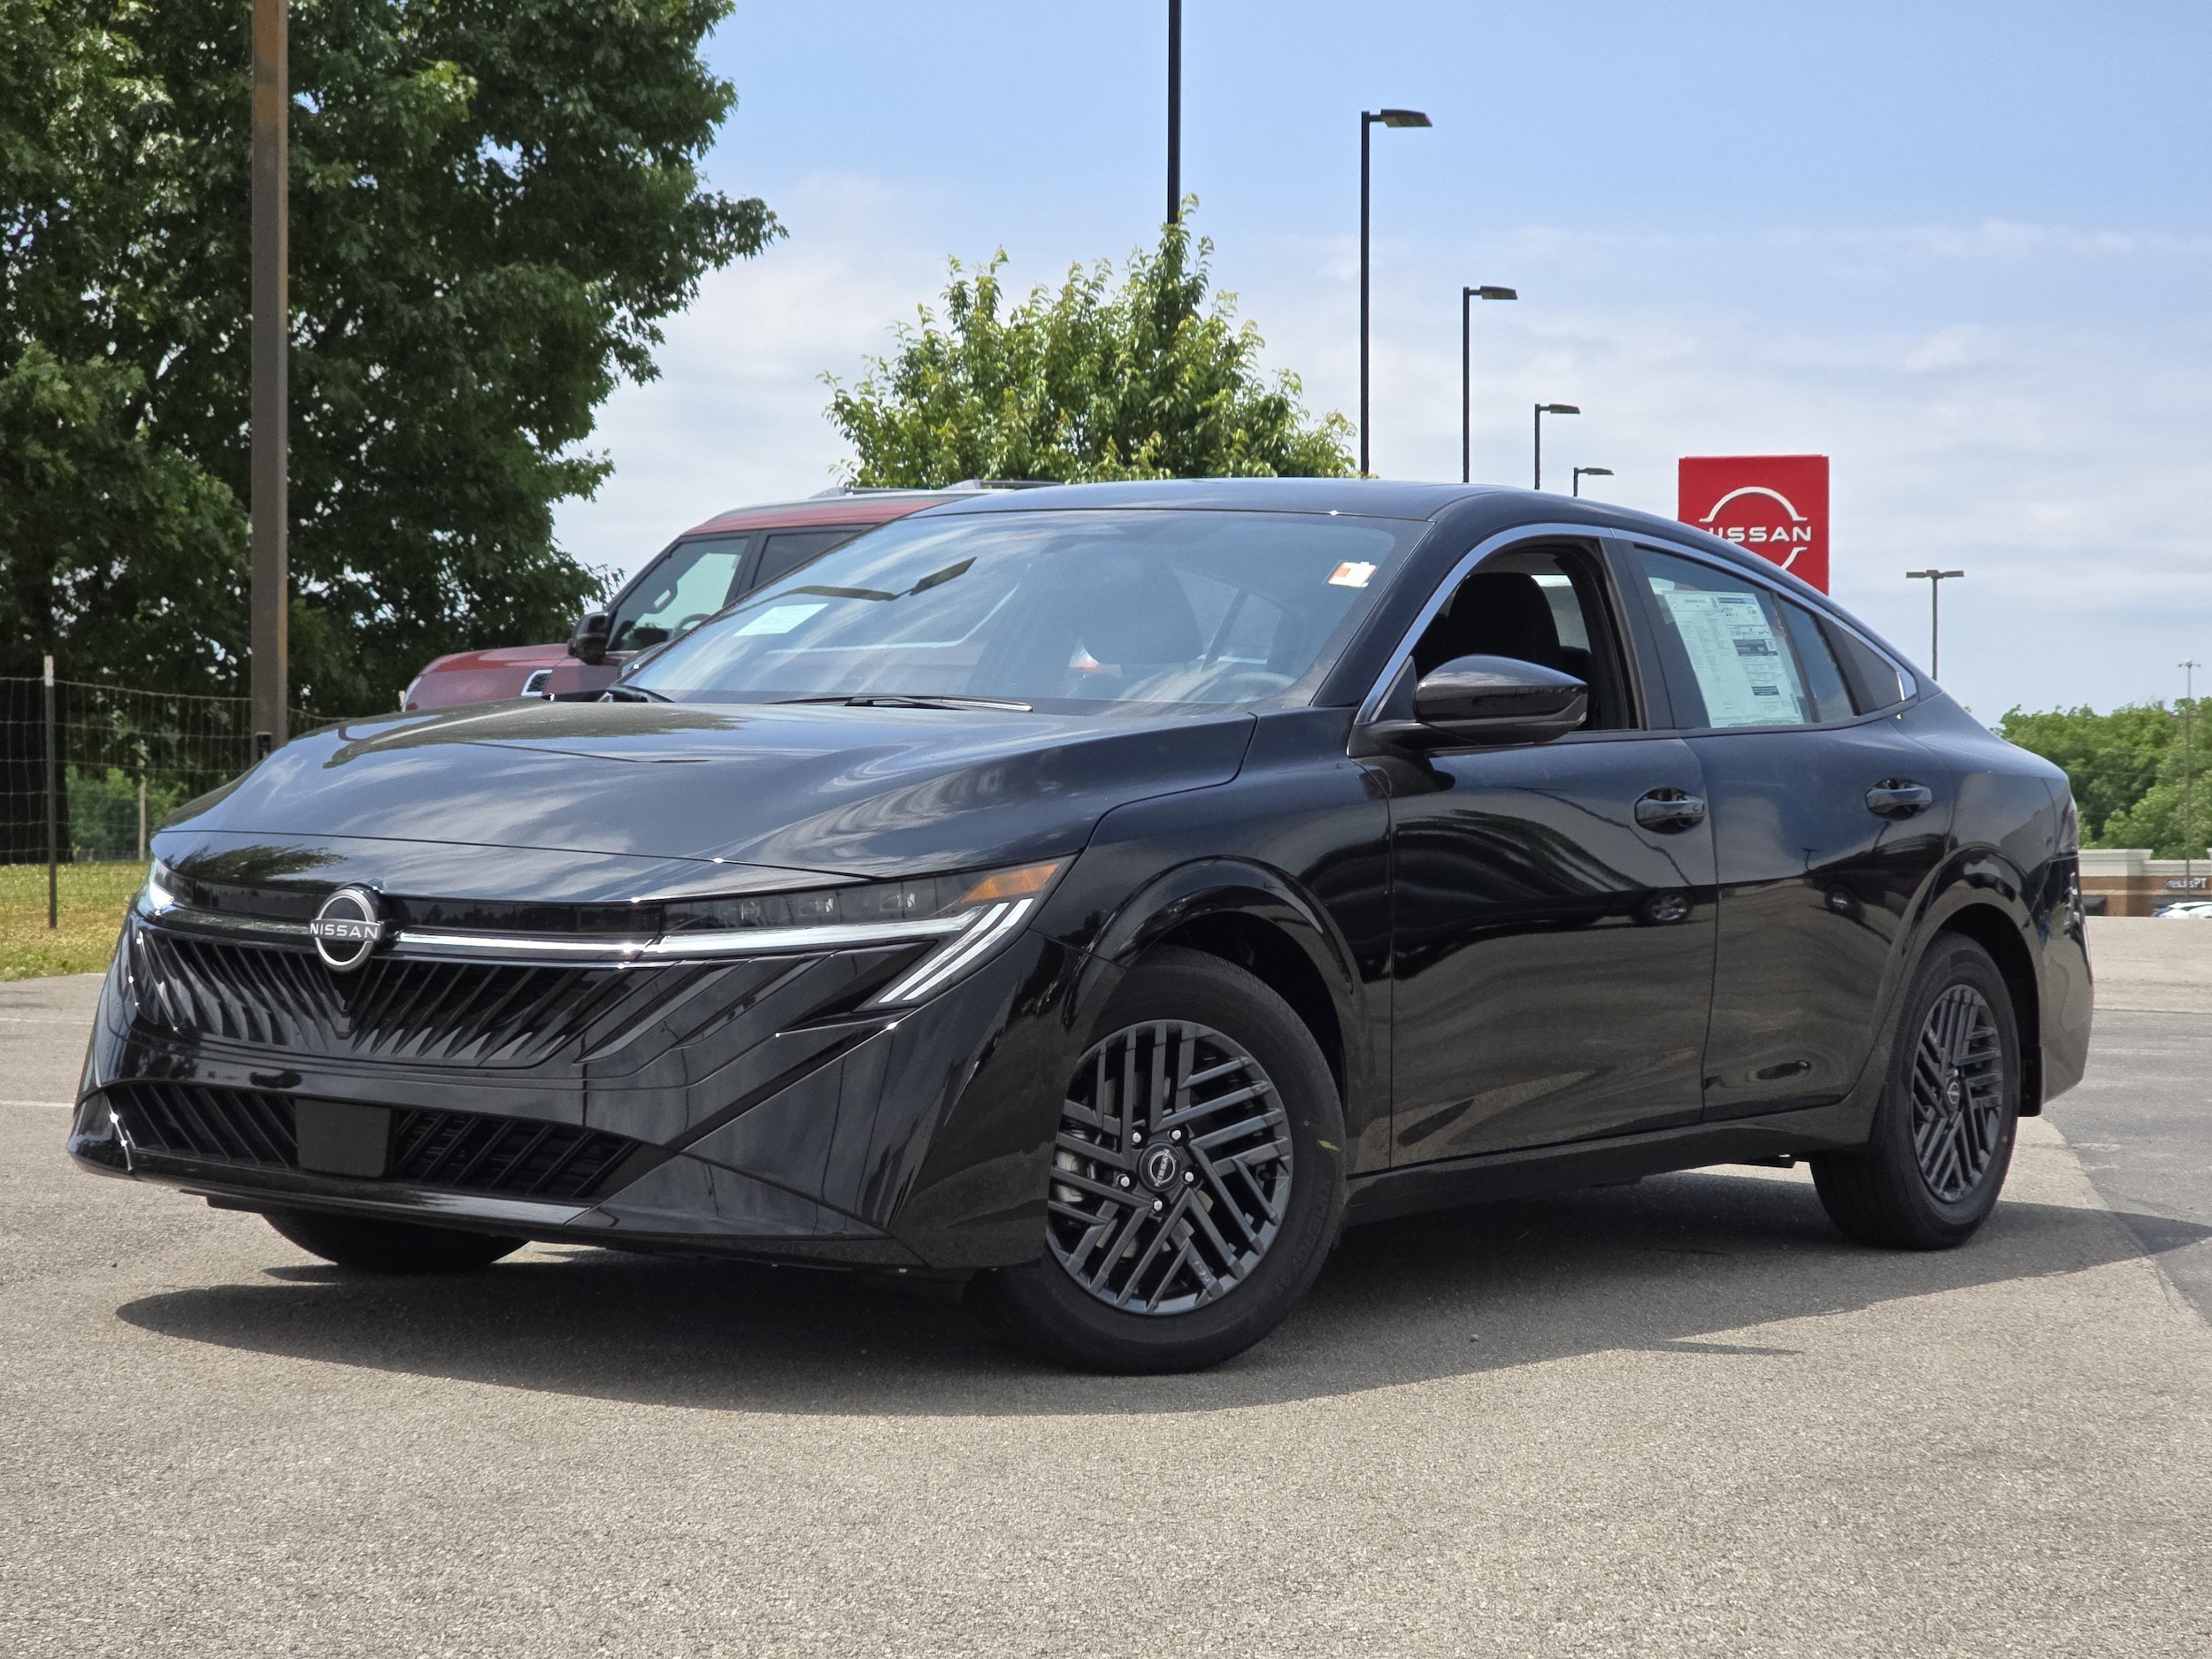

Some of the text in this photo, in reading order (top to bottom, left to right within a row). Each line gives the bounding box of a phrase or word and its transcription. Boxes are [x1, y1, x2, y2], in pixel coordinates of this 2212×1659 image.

[1707, 526, 1812, 543] ISSAN
[310, 922, 379, 940] NISSAN
[1154, 1148, 1170, 1187] NISSAN
